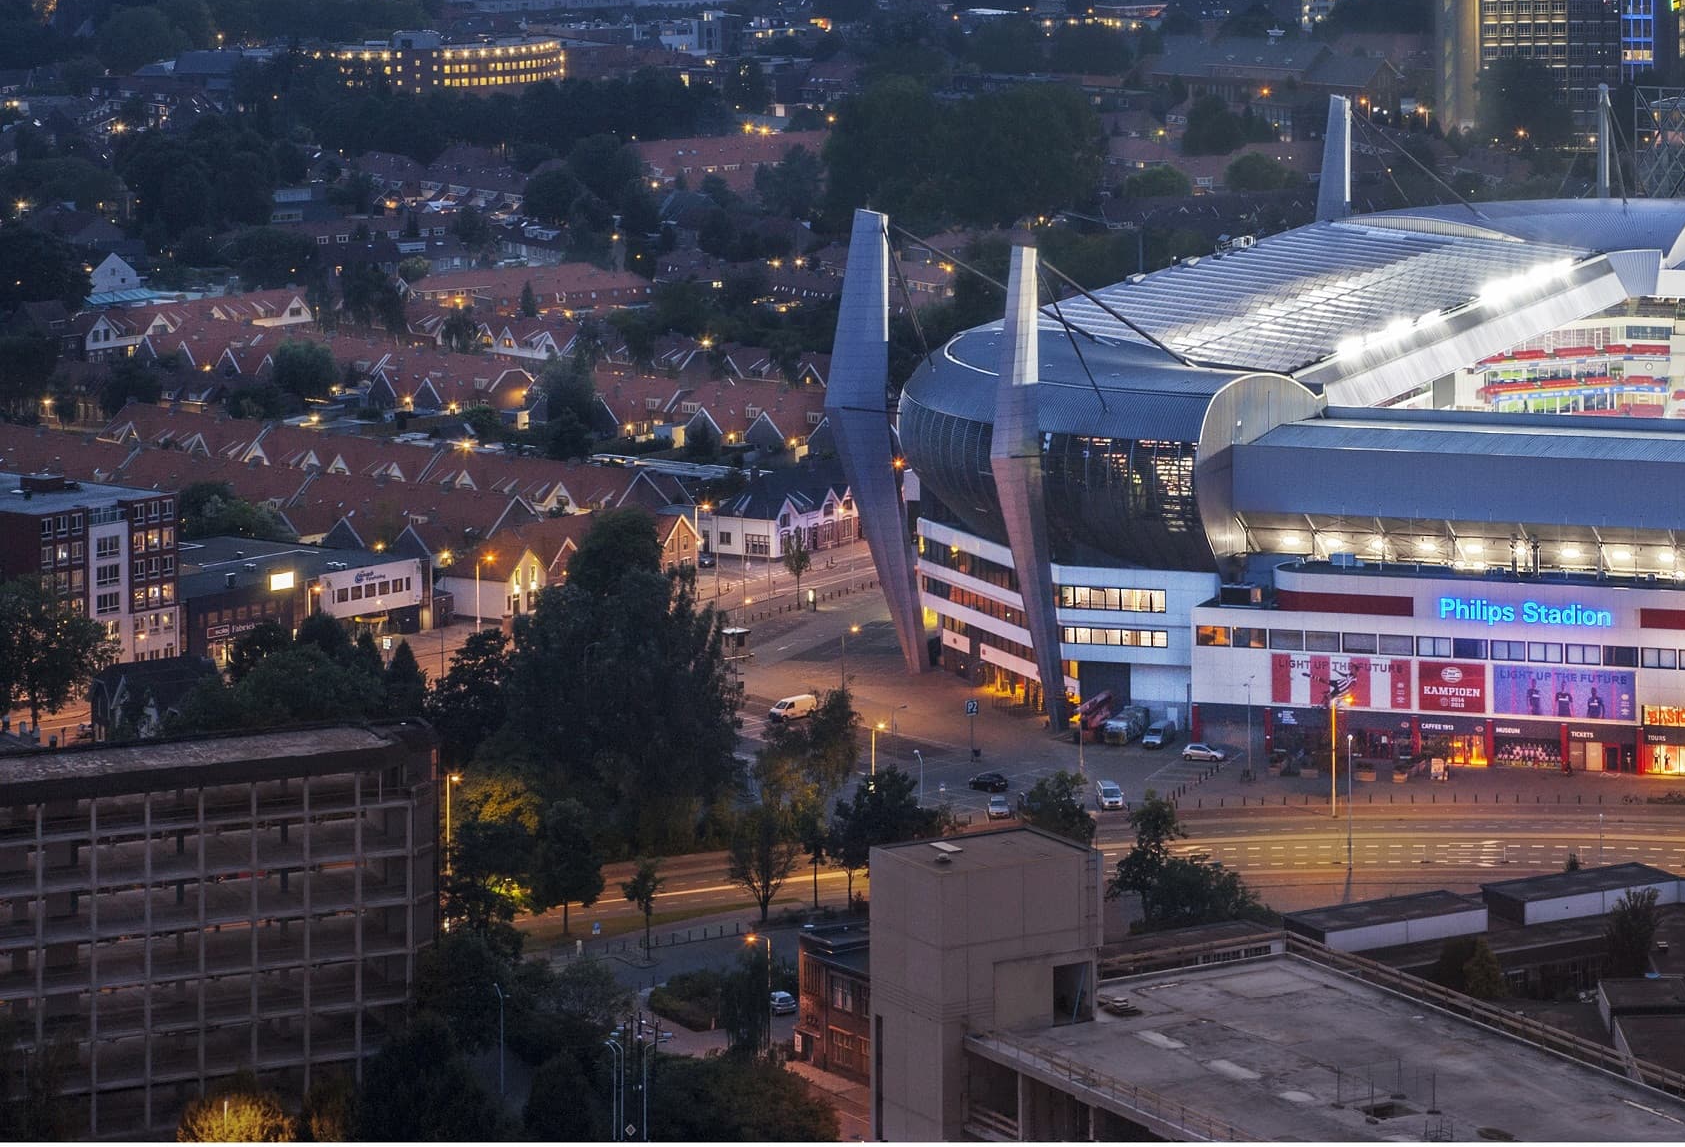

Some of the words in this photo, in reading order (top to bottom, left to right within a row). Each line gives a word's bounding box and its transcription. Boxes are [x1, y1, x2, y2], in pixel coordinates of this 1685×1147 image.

[1440, 598, 1515, 625] Philips
[1522, 601, 1612, 626] Stadion
[1278, 659, 1311, 669] LIGHT
[1314, 661, 1329, 670] UP
[1332, 661, 1353, 671] THE
[1359, 662, 1403, 673] FUTURE
[1500, 670, 1532, 679] LIGHT
[1536, 672, 1552, 681] UP
[1555, 673, 1577, 683] THE
[1580, 674, 1627, 685] FUTURE
[1423, 686, 1481, 697] KAMPIOEN
[967, 701, 978, 713] P2
[1571, 731, 1594, 739] TICKETS
[1648, 734, 1667, 742] TOURS
